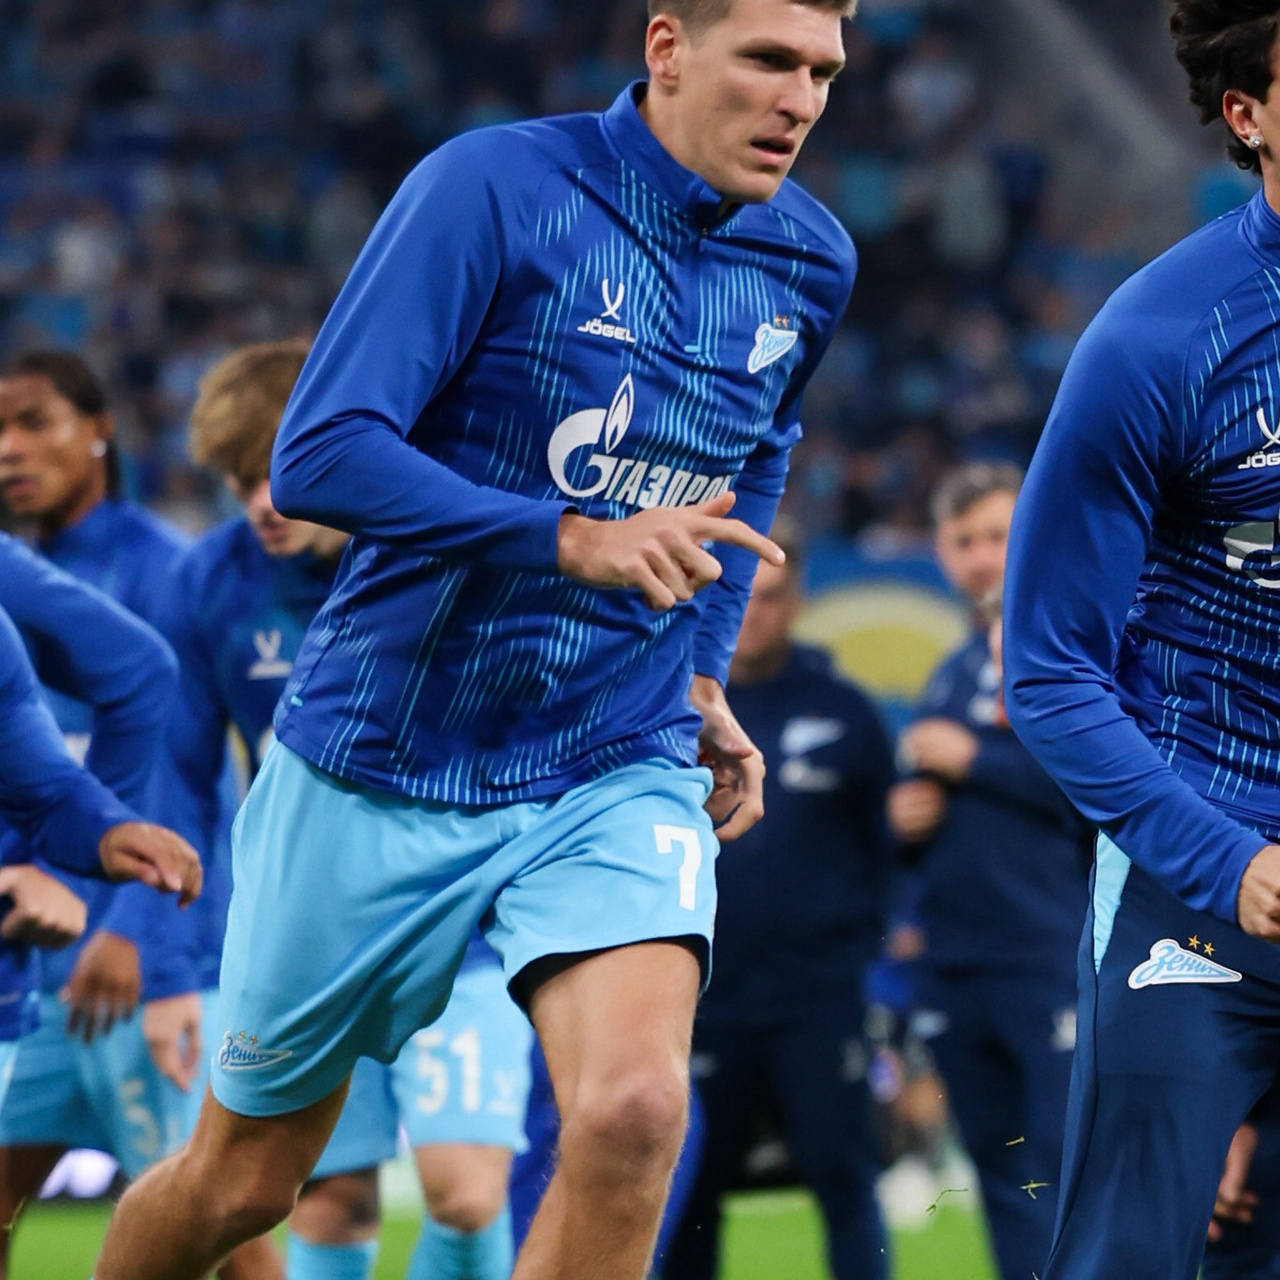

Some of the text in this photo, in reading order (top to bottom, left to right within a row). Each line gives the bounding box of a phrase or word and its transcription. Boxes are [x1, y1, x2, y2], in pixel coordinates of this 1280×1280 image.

[577, 318, 636, 343] JÖGEL
[653, 823, 702, 911] 7
[1134, 945, 1233, 984] Зенит
[413, 1028, 482, 1116] 51
